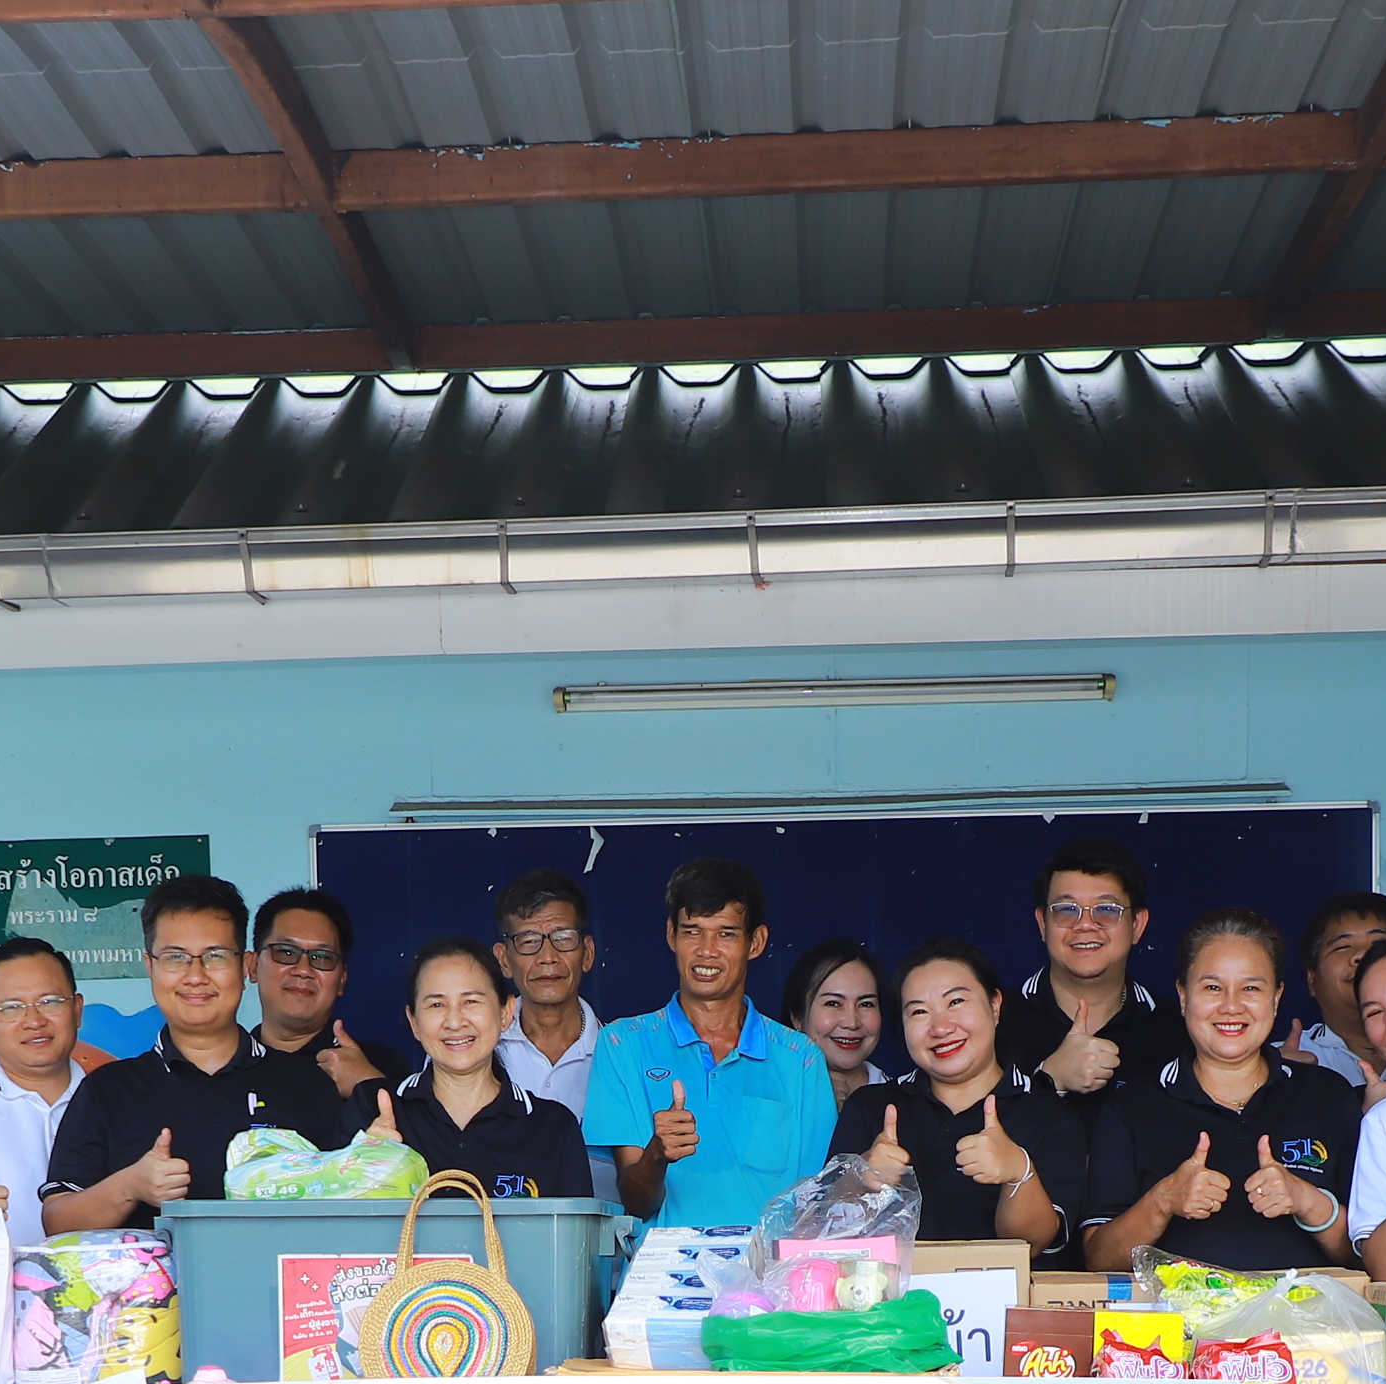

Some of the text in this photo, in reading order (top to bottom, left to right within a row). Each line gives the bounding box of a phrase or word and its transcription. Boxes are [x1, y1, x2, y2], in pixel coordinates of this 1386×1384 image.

[10, 908, 78, 926] พระราม
[1281, 1139, 1314, 1163] 51
[278, 1184, 298, 1195] 46
[493, 1174, 526, 1198] 51
